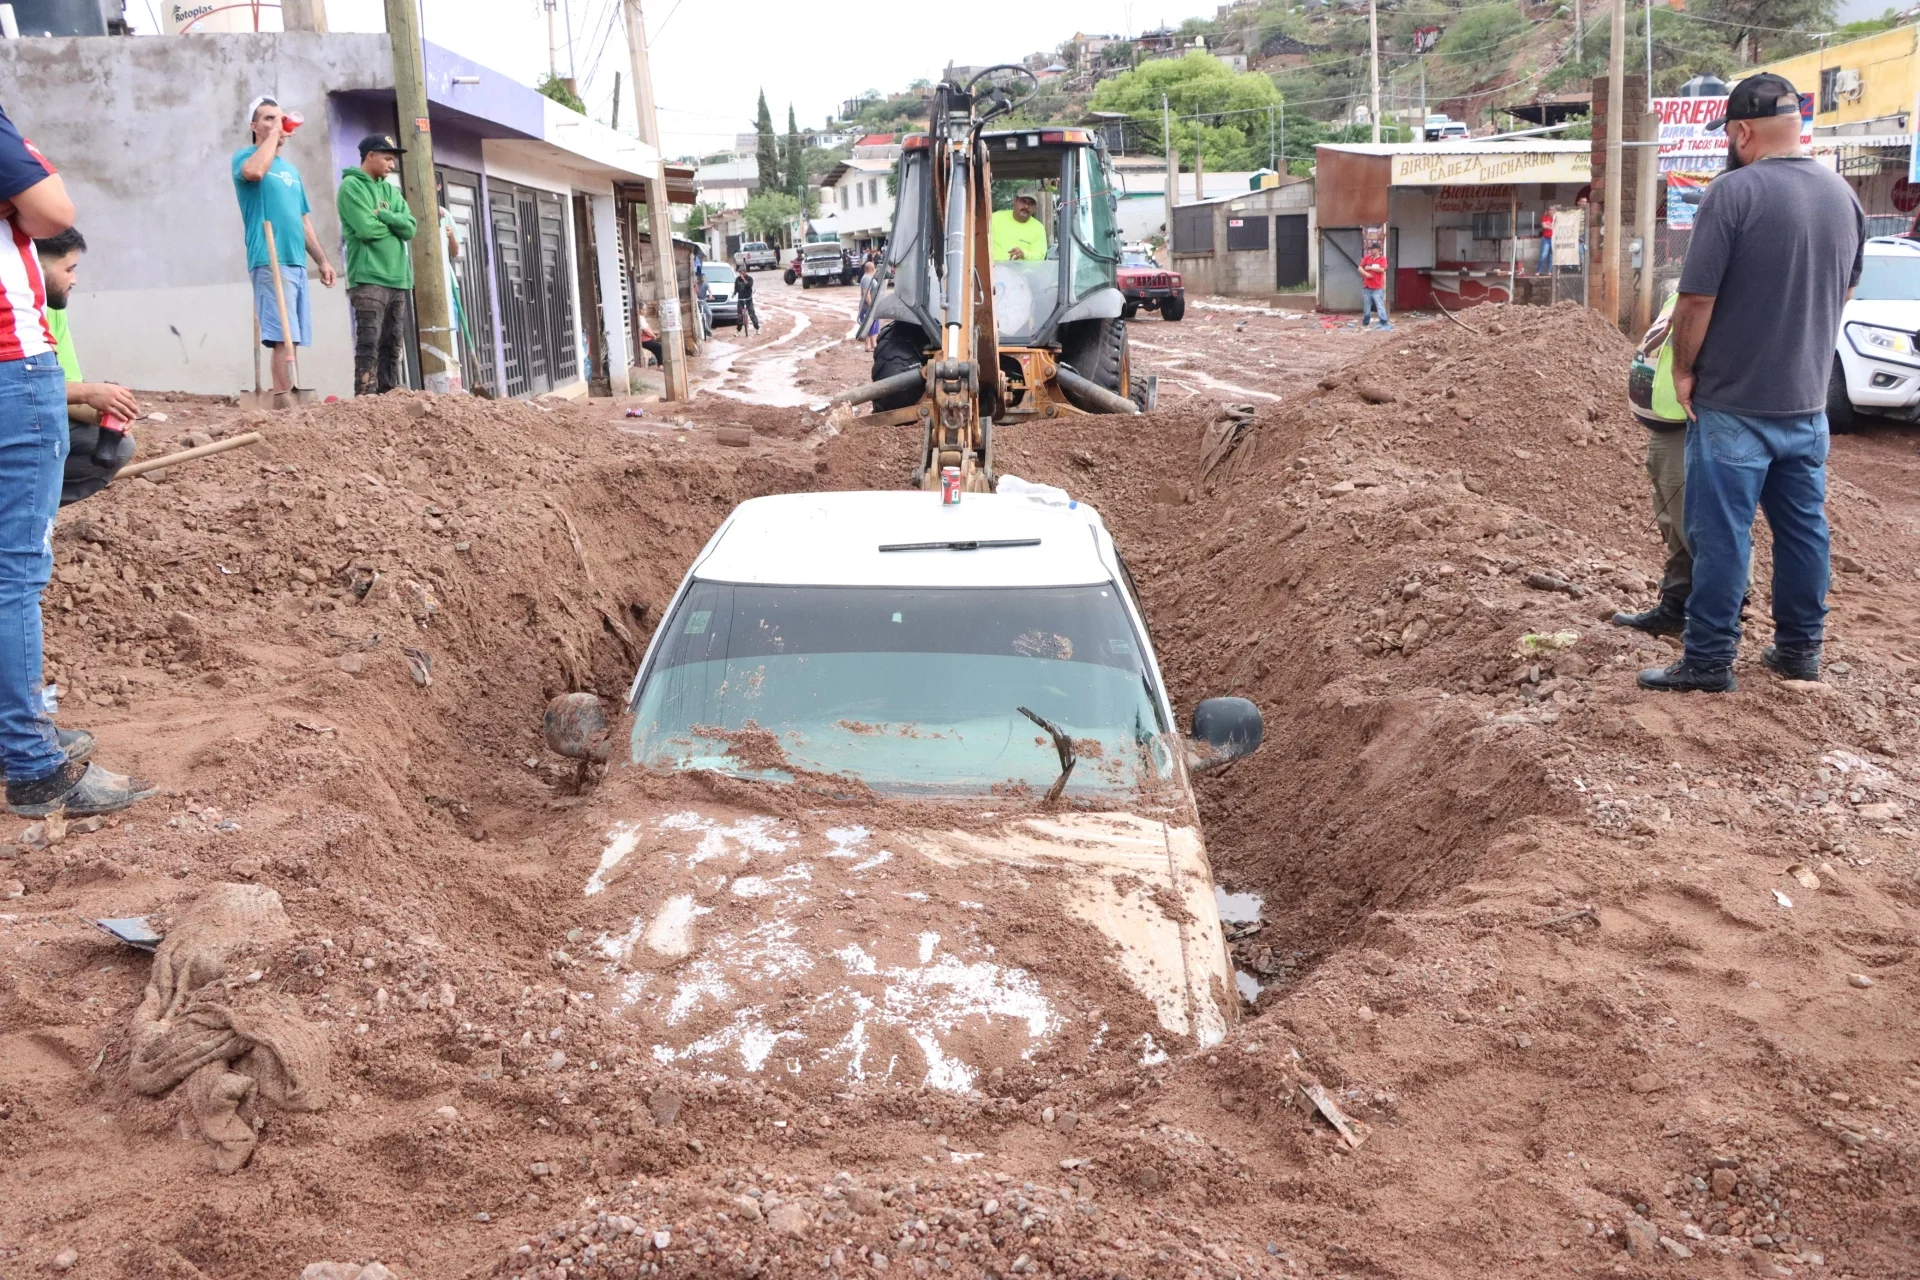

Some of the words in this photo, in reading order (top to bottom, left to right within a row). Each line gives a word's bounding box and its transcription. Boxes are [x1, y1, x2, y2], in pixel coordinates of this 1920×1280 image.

[175, 5, 213, 23] Rotoplas
[1653, 100, 1728, 124] BIRRIERIA
[1400, 154, 1445, 176] BIRRIA
[1429, 155, 1483, 182] CABEZA
[1479, 153, 1556, 182] CHICHARRON
[1574, 154, 1590, 163] CON
[1440, 184, 1518, 199] Bienvenido
